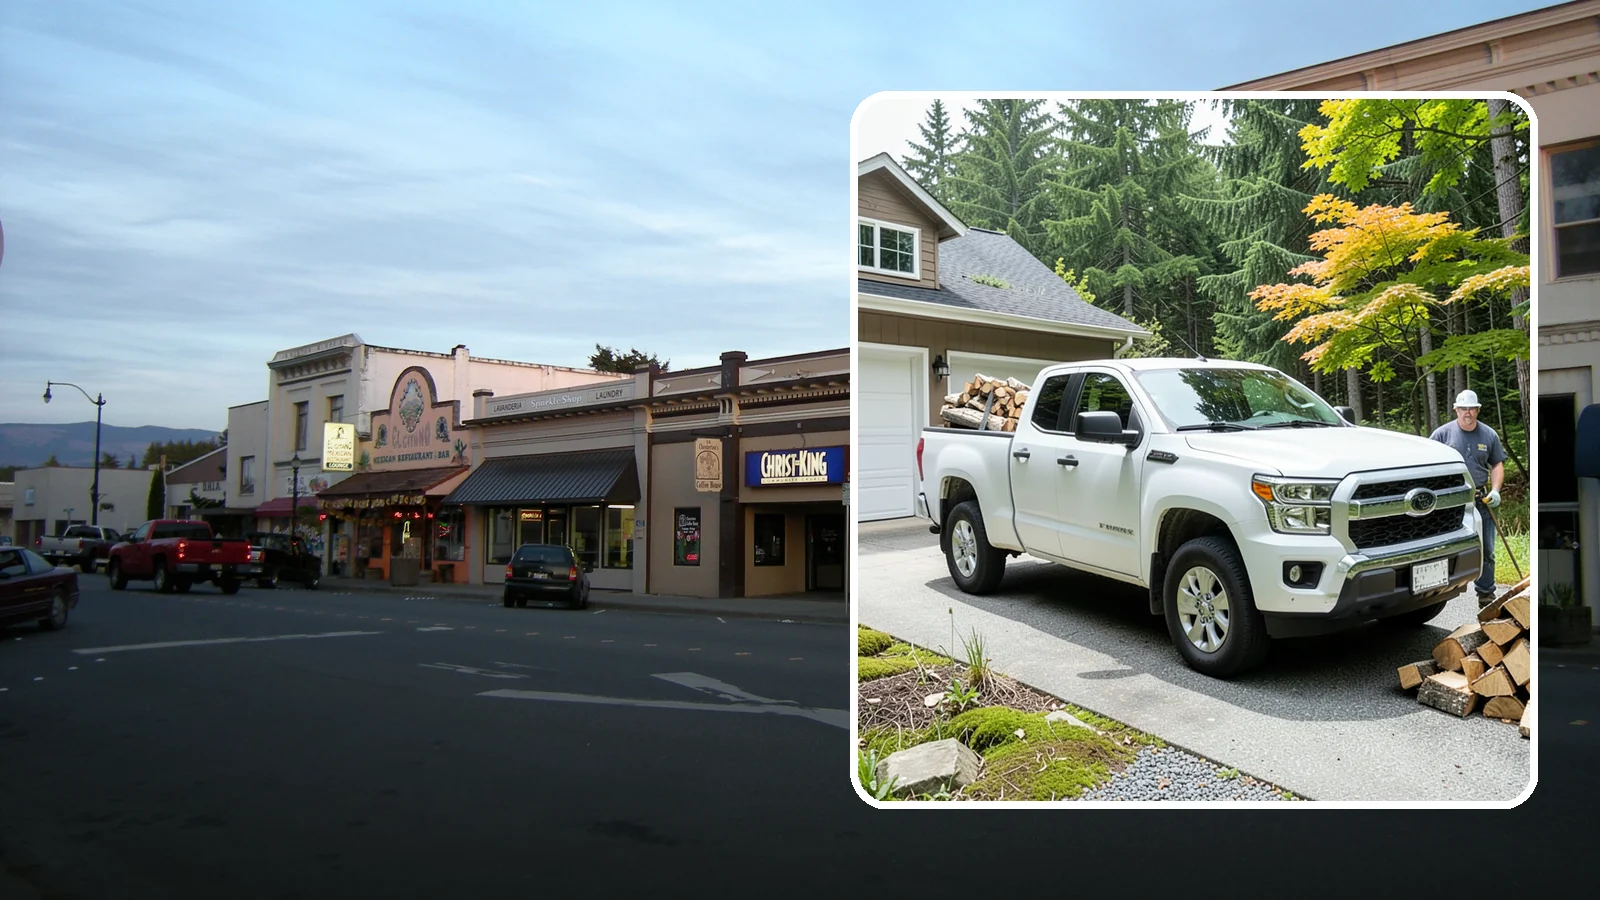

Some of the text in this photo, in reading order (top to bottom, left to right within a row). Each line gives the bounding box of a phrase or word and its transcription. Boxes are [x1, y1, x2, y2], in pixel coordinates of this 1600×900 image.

[596, 389, 623, 400] LAUNDRY
[562, 395, 582, 405] Shop
[493, 402, 522, 412] LAVANDERIA
[374, 455, 396, 464] MEXICAN
[397, 451, 433, 462] RESTAURANT
[438, 449, 450, 459] BAR
[799, 450, 827, 476] KING
[696, 481, 722, 489] Coffee House
